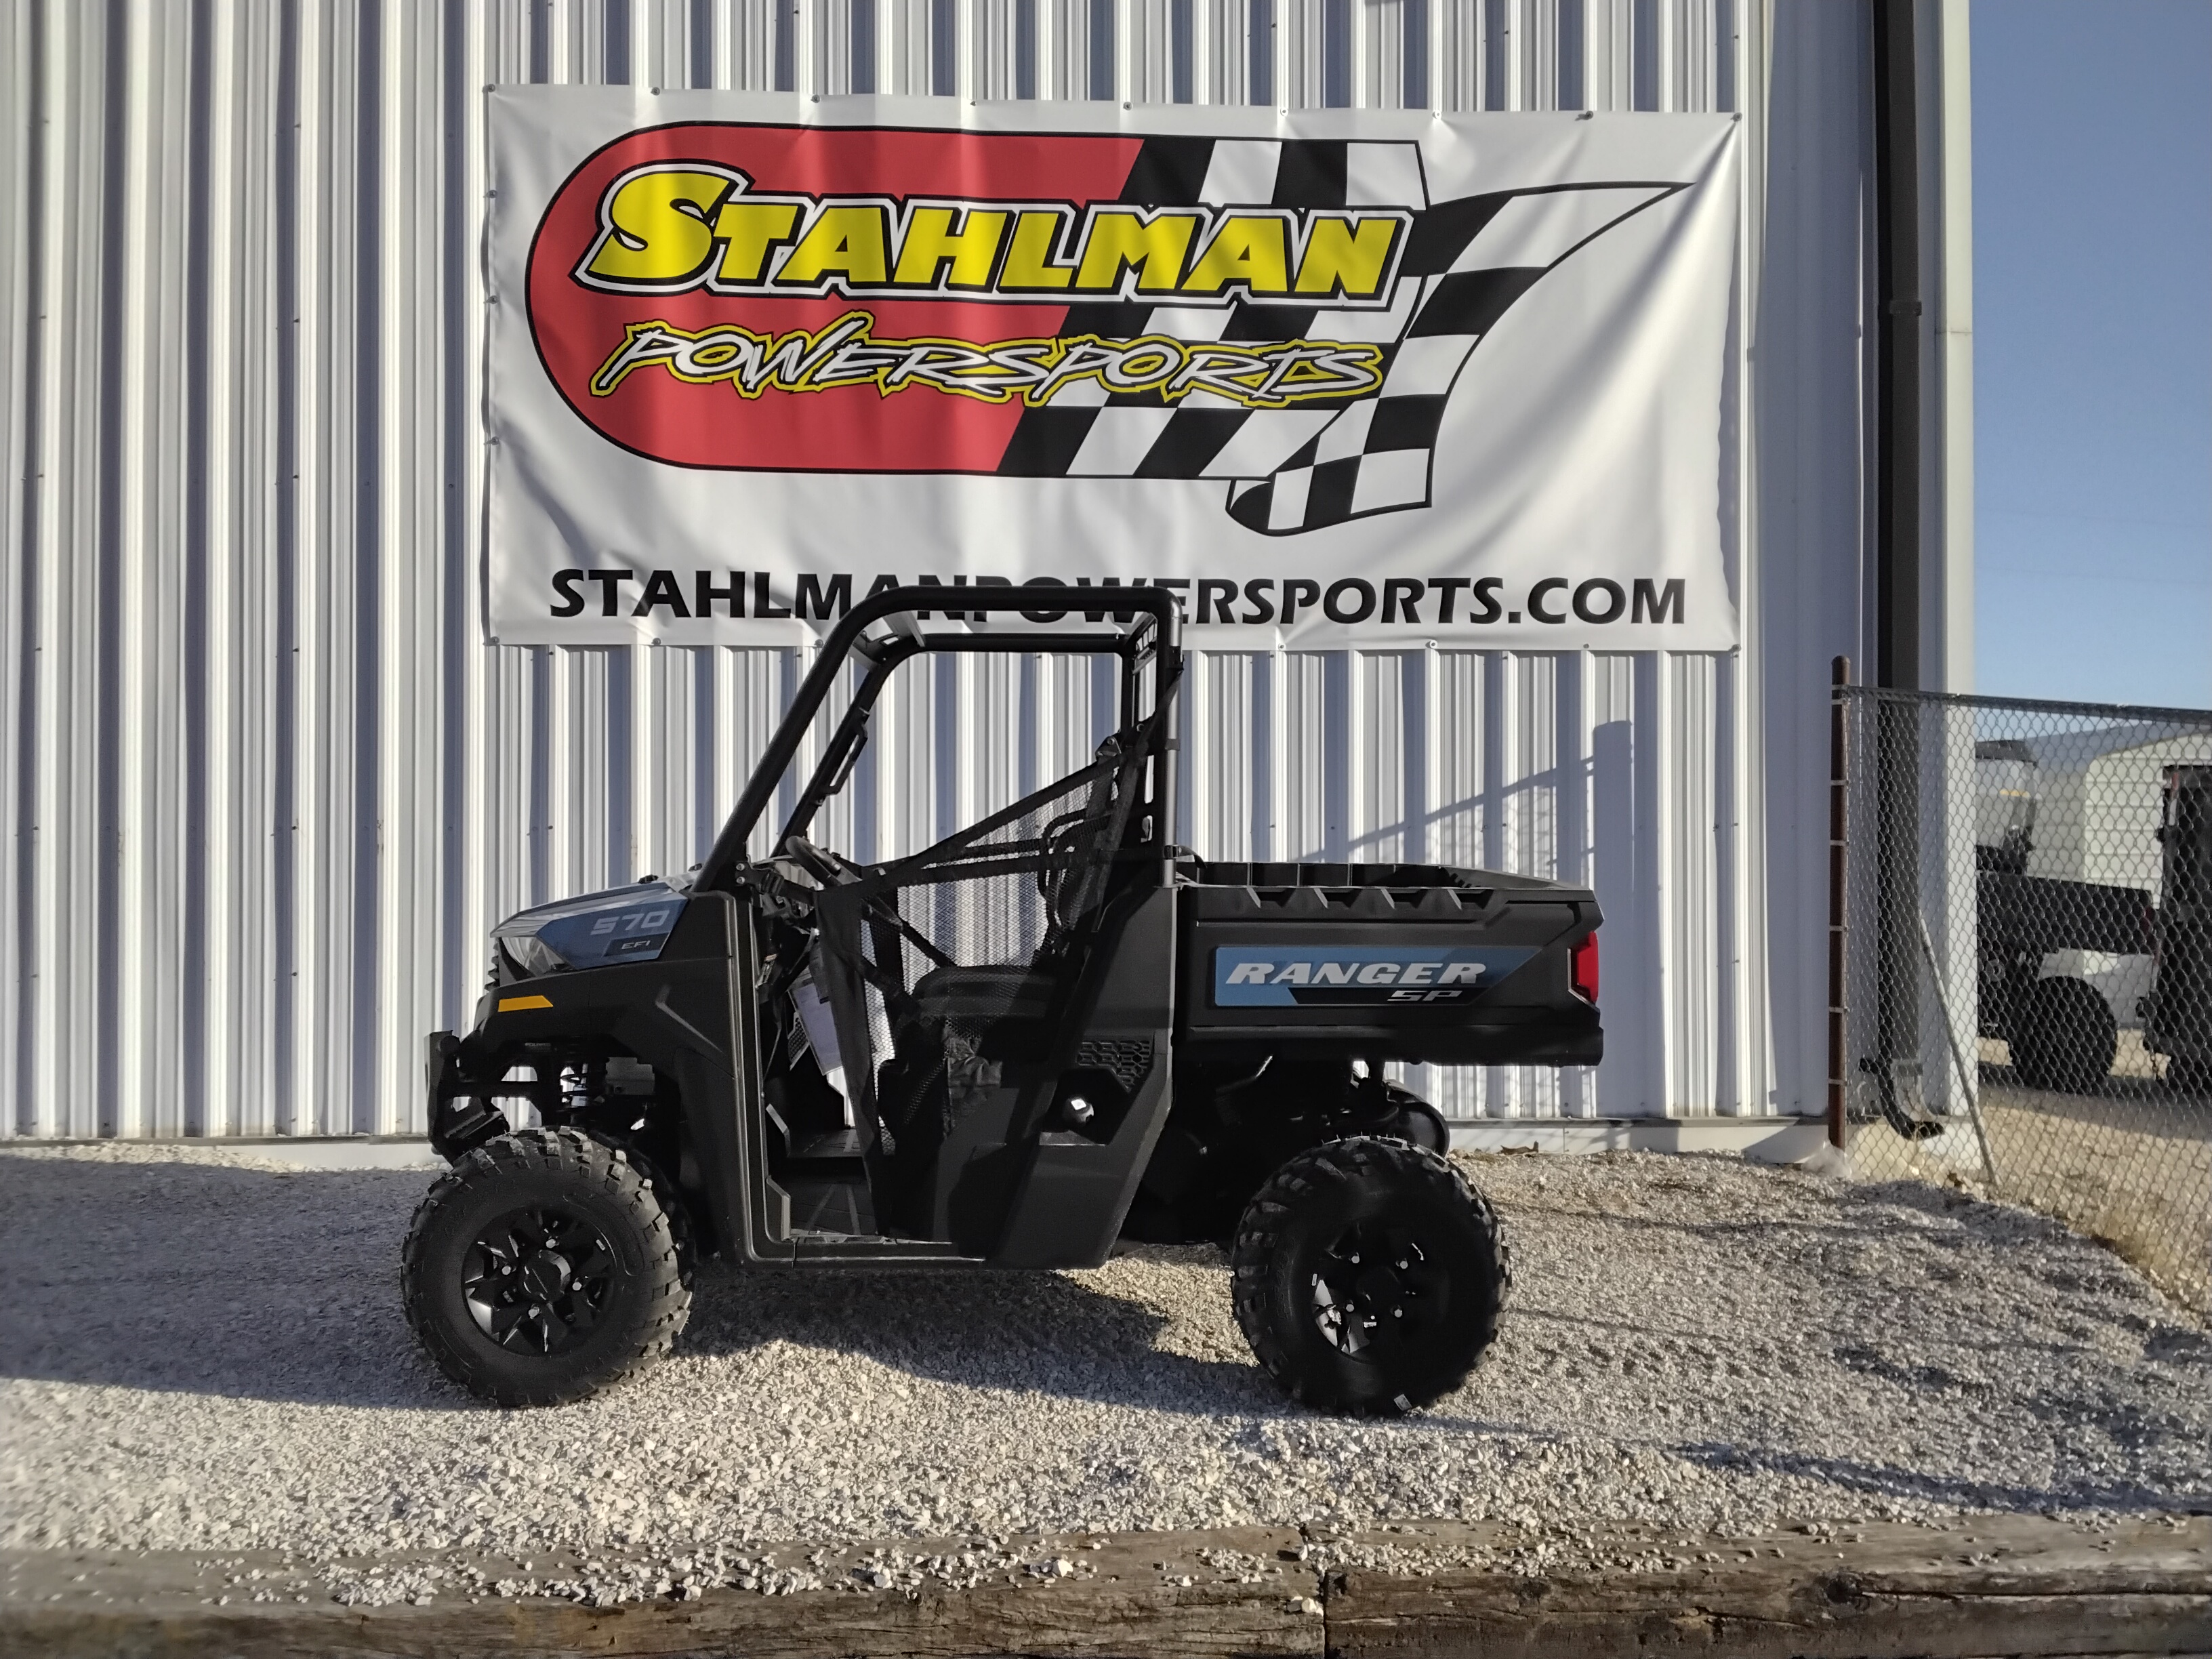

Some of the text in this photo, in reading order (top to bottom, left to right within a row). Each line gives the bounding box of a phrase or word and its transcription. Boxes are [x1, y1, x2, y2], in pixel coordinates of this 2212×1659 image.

[578, 164, 1407, 304] STAHLMAN
[595, 313, 1380, 403] POWERSPORTS
[590, 909, 670, 935] 570
[621, 940, 651, 949] EFI
[1225, 962, 1486, 985] RANGER
[1387, 989, 1463, 1002] SP
